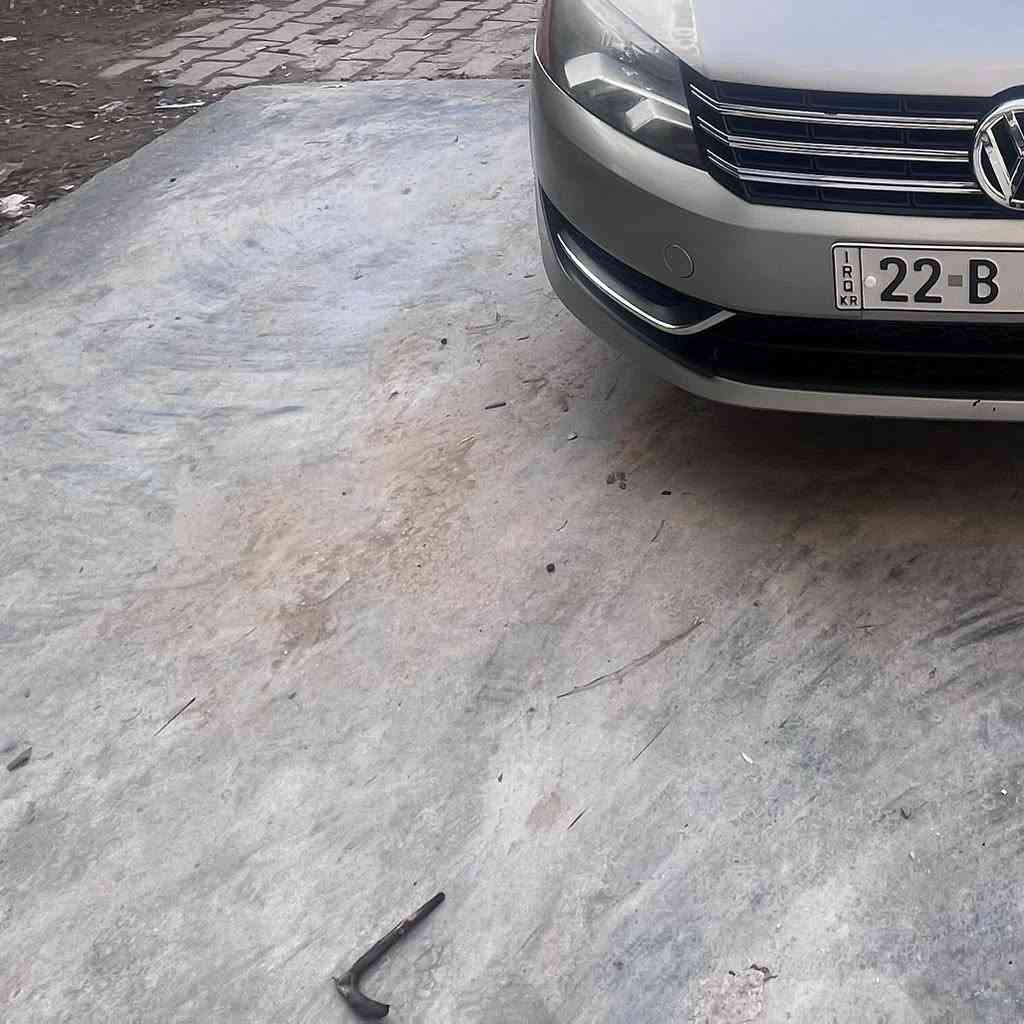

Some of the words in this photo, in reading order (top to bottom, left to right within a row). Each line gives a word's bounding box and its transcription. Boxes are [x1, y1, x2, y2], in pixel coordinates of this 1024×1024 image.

[879, 256, 943, 304] 22
[968, 258, 1000, 305] B
[840, 295, 858, 306] KR
